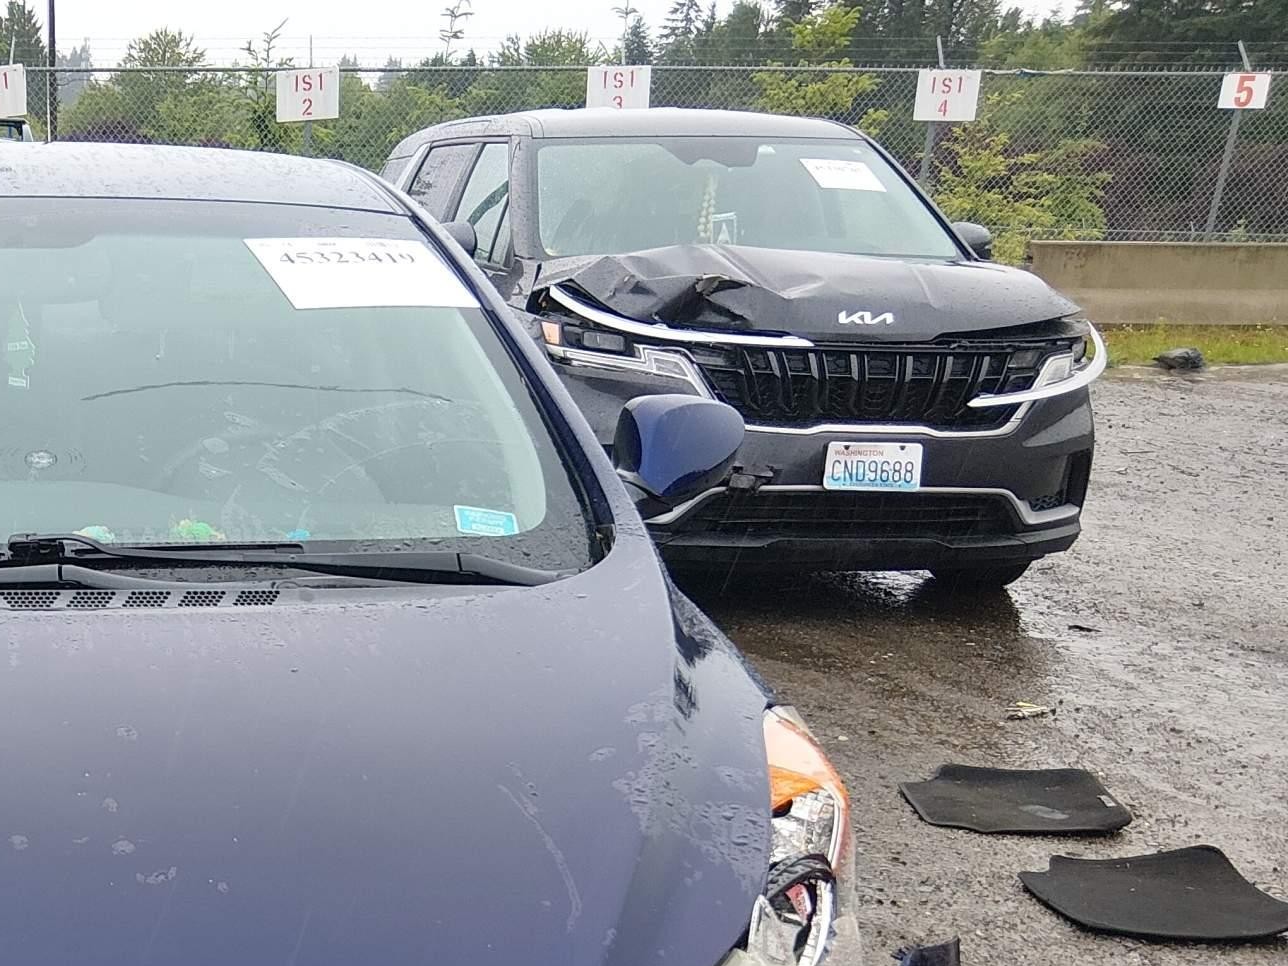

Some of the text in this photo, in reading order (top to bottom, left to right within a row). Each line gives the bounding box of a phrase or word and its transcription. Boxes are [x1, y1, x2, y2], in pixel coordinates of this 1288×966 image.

[1234, 75, 1257, 108] 5
[302, 98, 313, 116] 2
[613, 95, 623, 109] 3
[937, 99, 948, 117] 4
[834, 449, 884, 457] WASHINGTON
[831, 459, 914, 483] CND9688
